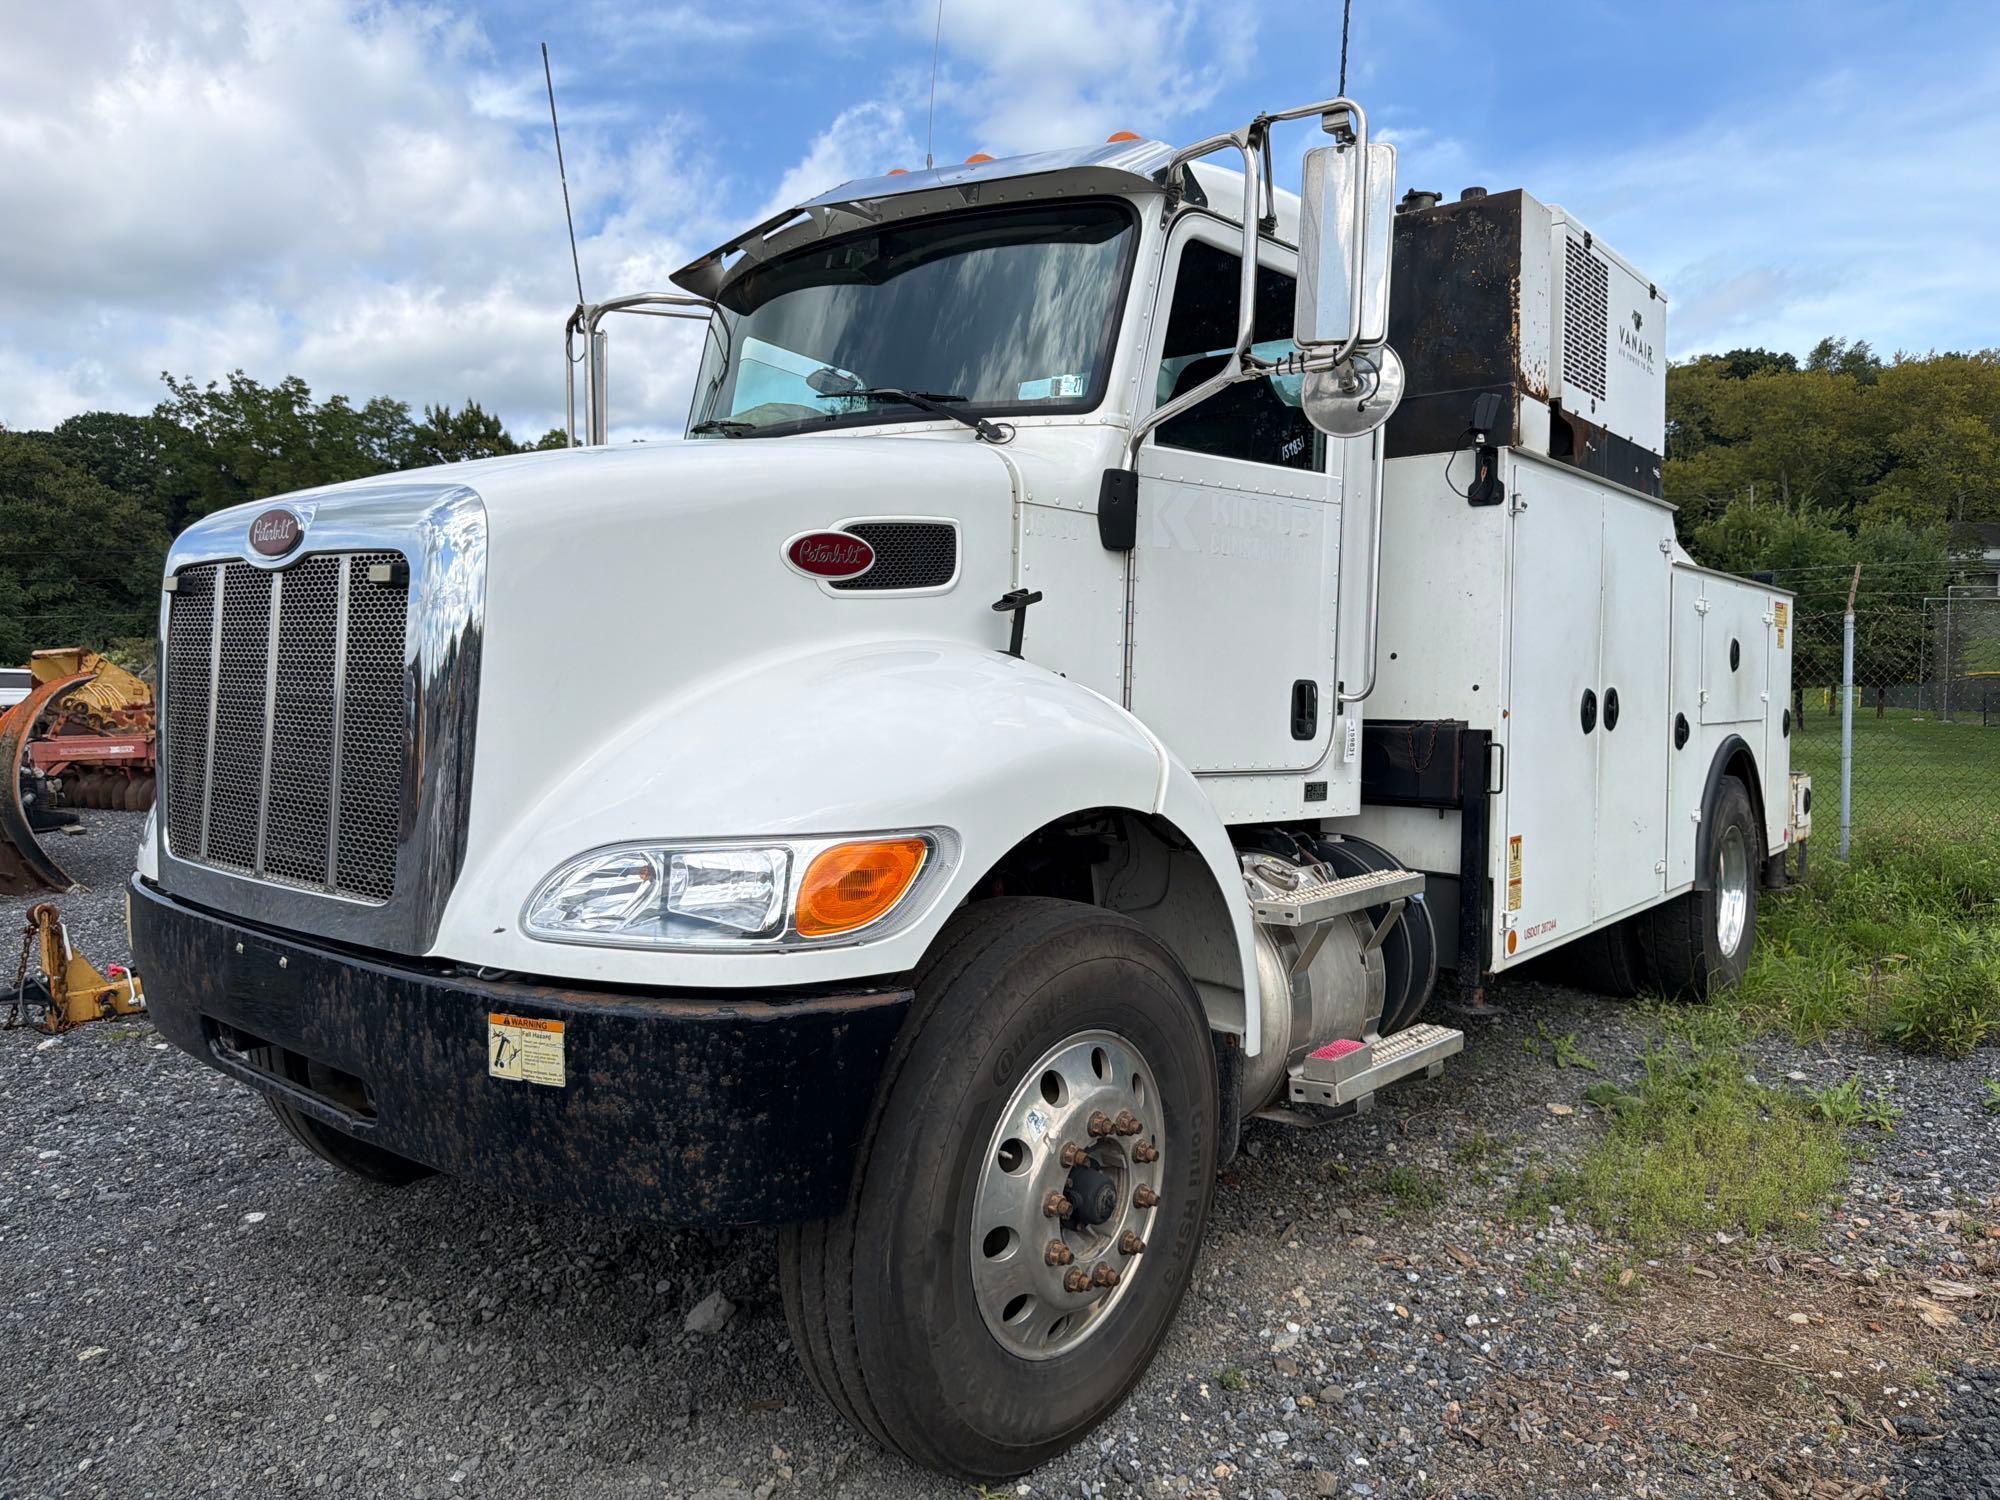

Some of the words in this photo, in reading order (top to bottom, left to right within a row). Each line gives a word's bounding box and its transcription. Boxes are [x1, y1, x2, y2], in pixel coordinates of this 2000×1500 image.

[1619, 325, 1653, 363] VANAIR
[1073, 377, 1081, 393] 27
[1282, 435, 1304, 461] 159831
[254, 519, 294, 544] Peterbilt
[800, 540, 866, 564] Peterbilt
[1524, 924, 1540, 940] USDOT
[511, 1017, 548, 1030] WARNING
[533, 1031, 551, 1040] Hazard
